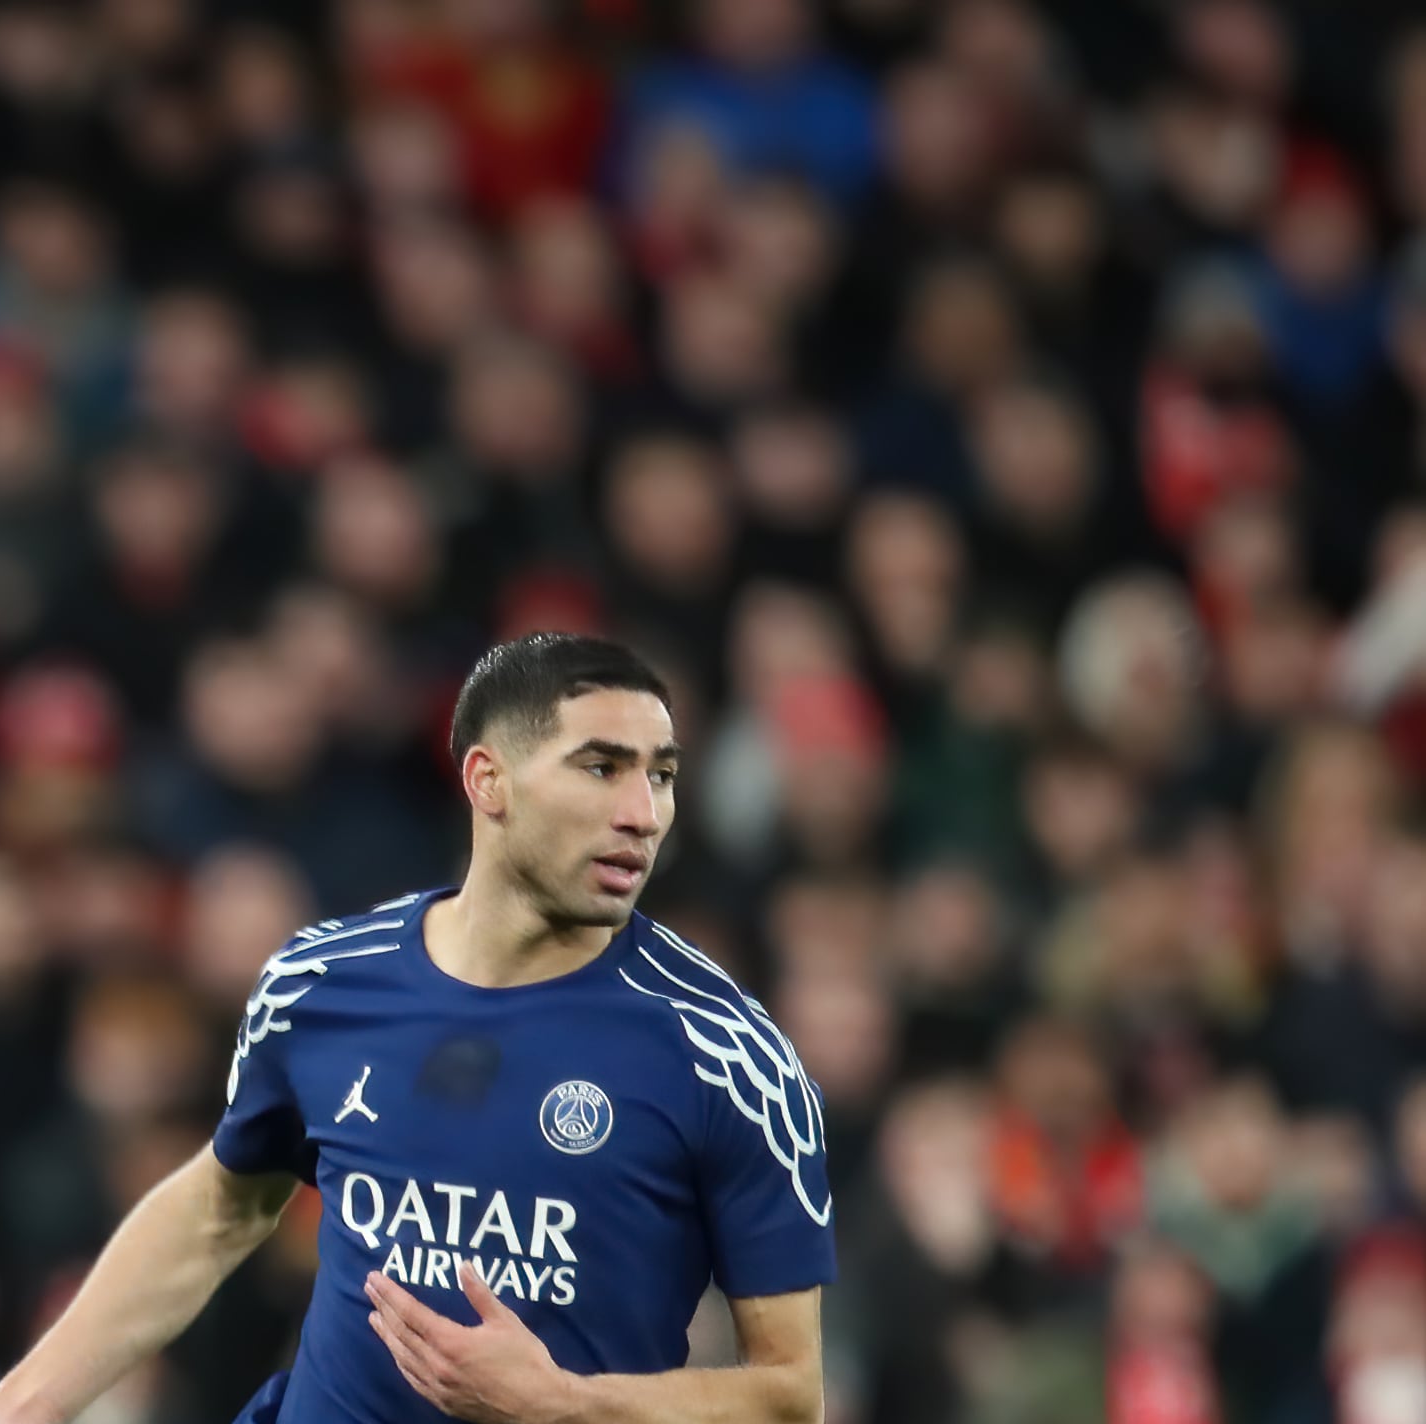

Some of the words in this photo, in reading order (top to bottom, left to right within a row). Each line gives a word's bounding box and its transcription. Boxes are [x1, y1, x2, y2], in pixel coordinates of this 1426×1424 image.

[556, 1083, 605, 1108] PARIS
[341, 1171, 579, 1263] QATAR
[381, 1242, 577, 1306] AIRWAYS
